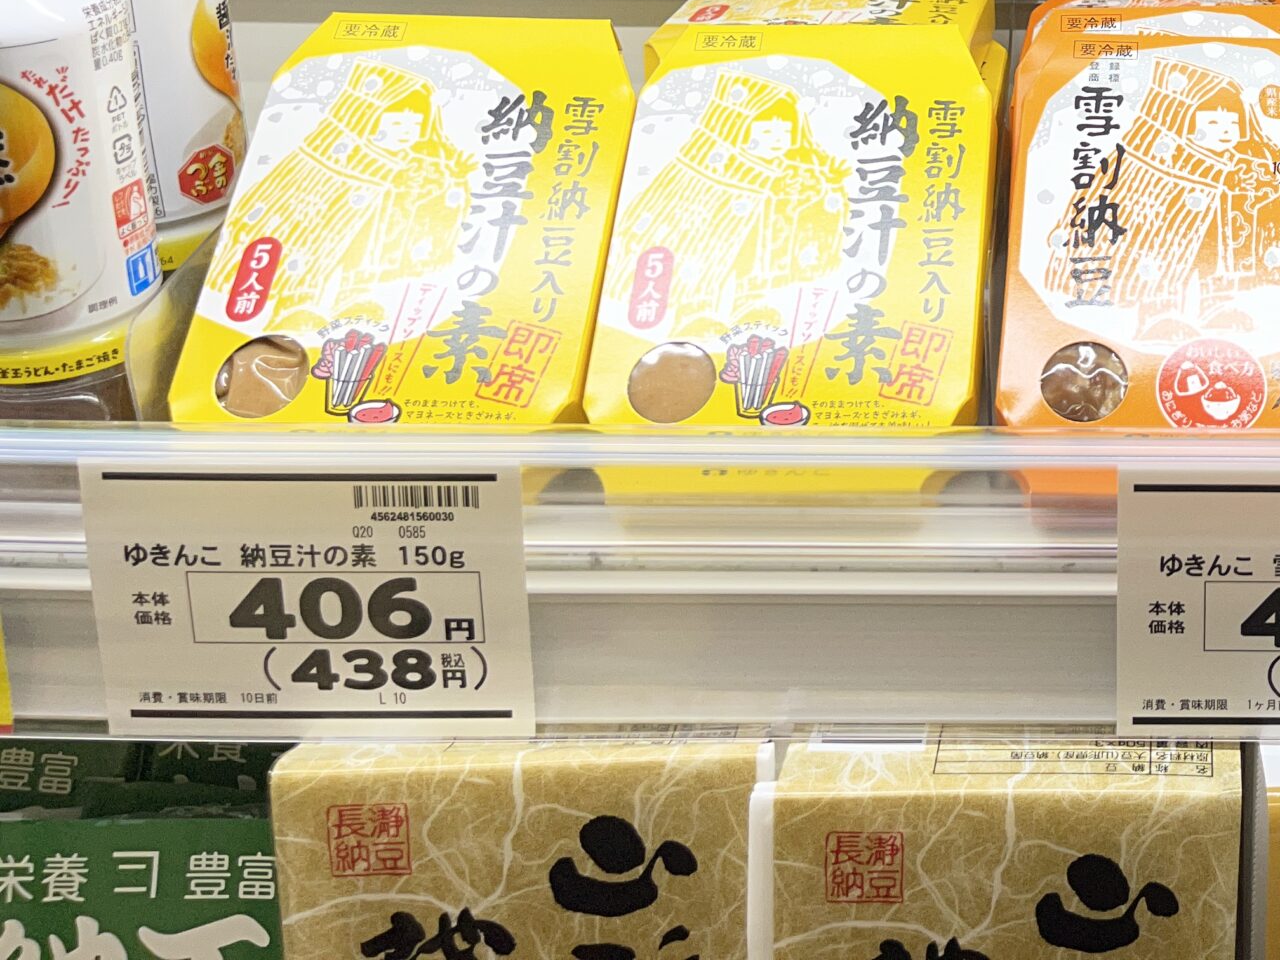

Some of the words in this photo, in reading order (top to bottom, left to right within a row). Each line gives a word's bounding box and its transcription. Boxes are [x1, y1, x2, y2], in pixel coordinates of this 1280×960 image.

[341, 23, 401, 40] 要冷蔵
[1065, 17, 1118, 30] 要冷蔵
[702, 33, 758, 50] 要冷蔵
[1078, 42, 1135, 59] 要冷蔵
[111, 112, 126, 123] PET
[529, 95, 605, 323] 雪割納豆入り
[1062, 85, 1129, 309] 雪割納豆
[916, 99, 967, 323] 雪割納豆入り
[423, 89, 555, 385] 納豆汁の素
[823, 94, 921, 387] 納豆汁の素
[232, 243, 273, 316] 5人前
[634, 251, 665, 323] 5人前
[488, 326, 556, 403] 即席
[888, 326, 947, 402] 即席
[1207, 361, 1255, 377] 食べ方
[369, 510, 455, 523] 4562481560030
[398, 525, 427, 539] 0585
[122, 543, 222, 568] ゆきんこ
[240, 543, 377, 569] 納豆汁の素
[397, 545, 466, 569] 150g
[1158, 553, 1254, 577] ゆきんこ
[131, 591, 170, 607] 本体
[228, 576, 432, 641] 406
[444, 618, 476, 641] 円
[1148, 600, 1186, 617] 本体
[133, 610, 173, 626] 価格
[1148, 619, 1186, 635] 価格
[440, 653, 465, 669] 税込
[138, 691, 228, 705] 消費・賞味期限
[240, 691, 278, 705] 10日前
[378, 691, 386, 705] L
[392, 691, 407, 705] 10
[1141, 698, 1229, 712] 消費・賞味期限
[0, 746, 79, 795] 豊富
[334, 839, 408, 873] 納豆
[0, 852, 90, 904] 栄養
[182, 850, 277, 901] 豊富
[831, 870, 899, 899] 納豆
